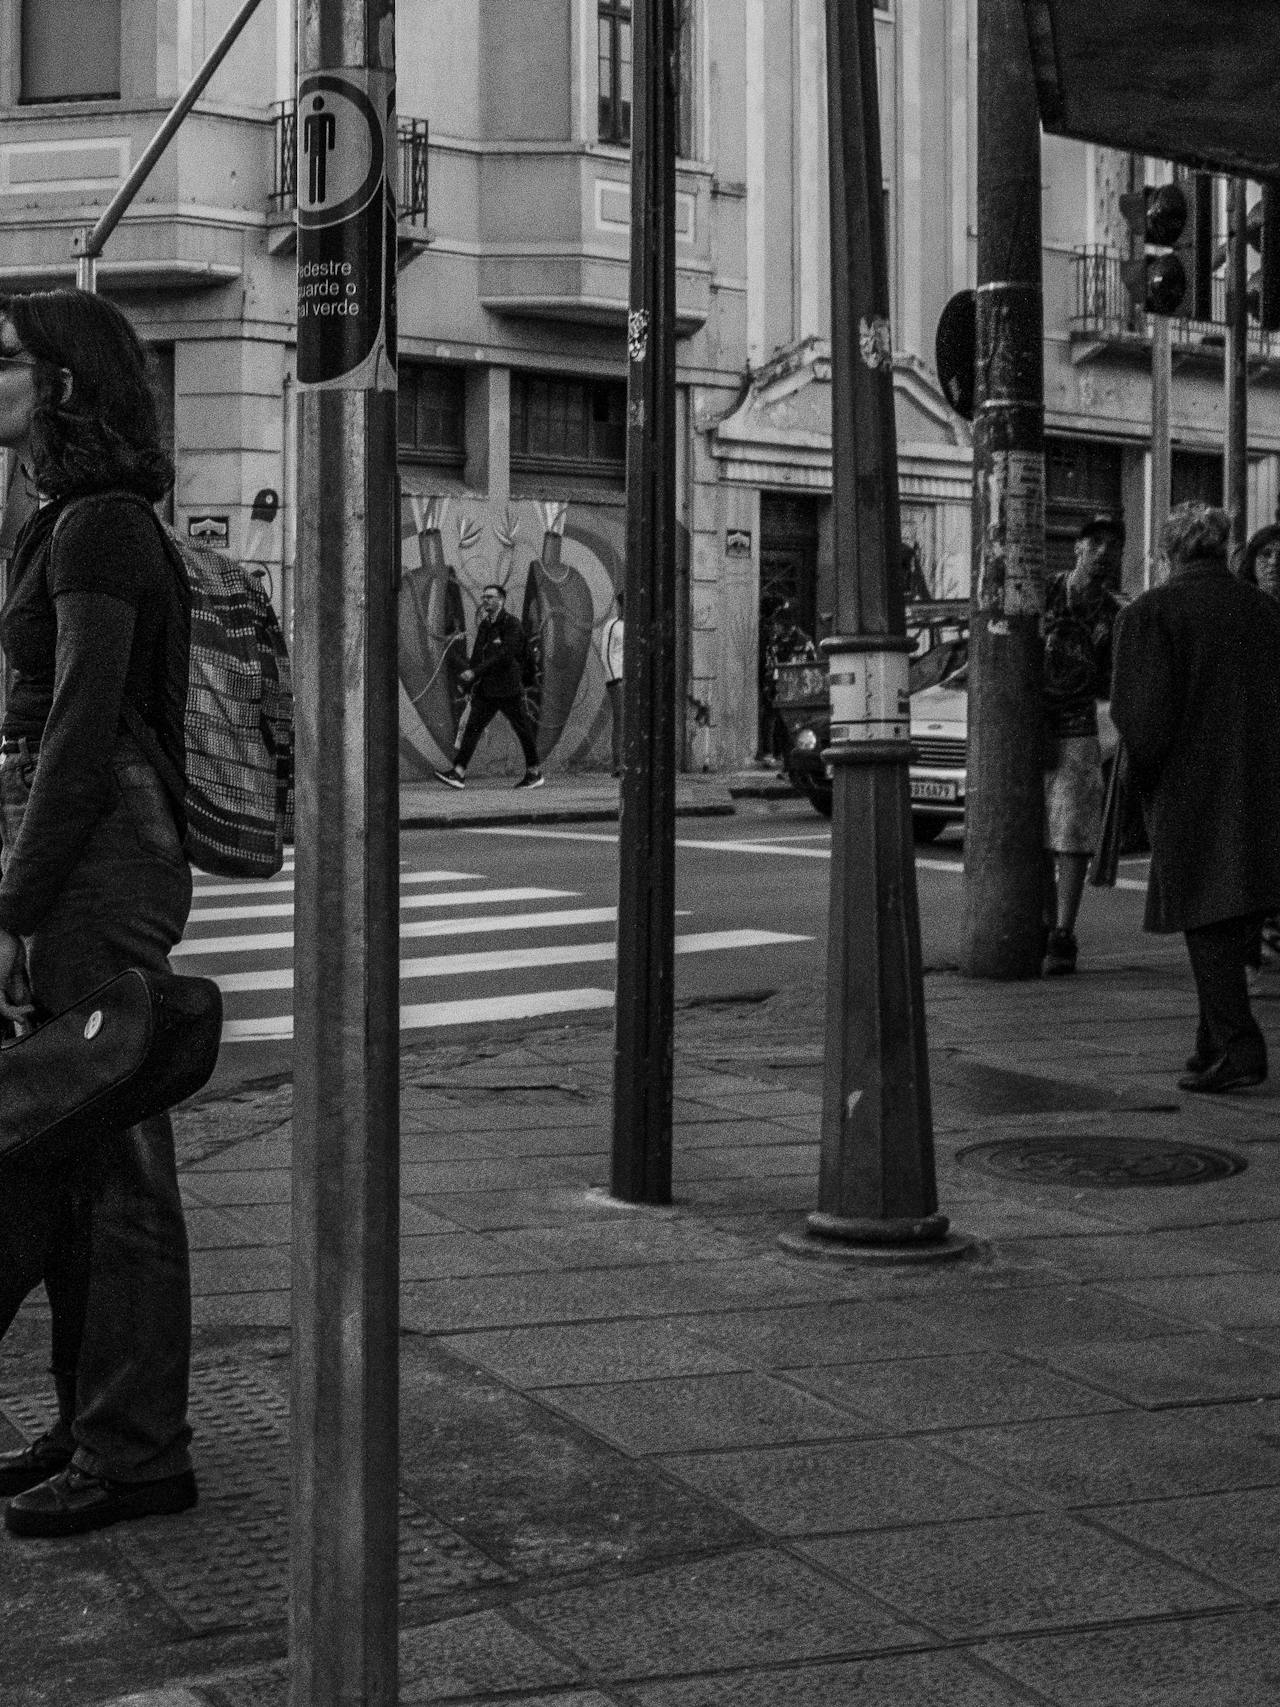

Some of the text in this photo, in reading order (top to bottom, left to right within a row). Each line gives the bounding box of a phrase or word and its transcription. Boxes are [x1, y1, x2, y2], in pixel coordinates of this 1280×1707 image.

[297, 260, 352, 278] edestre
[298, 279, 357, 299] uarde o
[312, 298, 360, 316] verde
